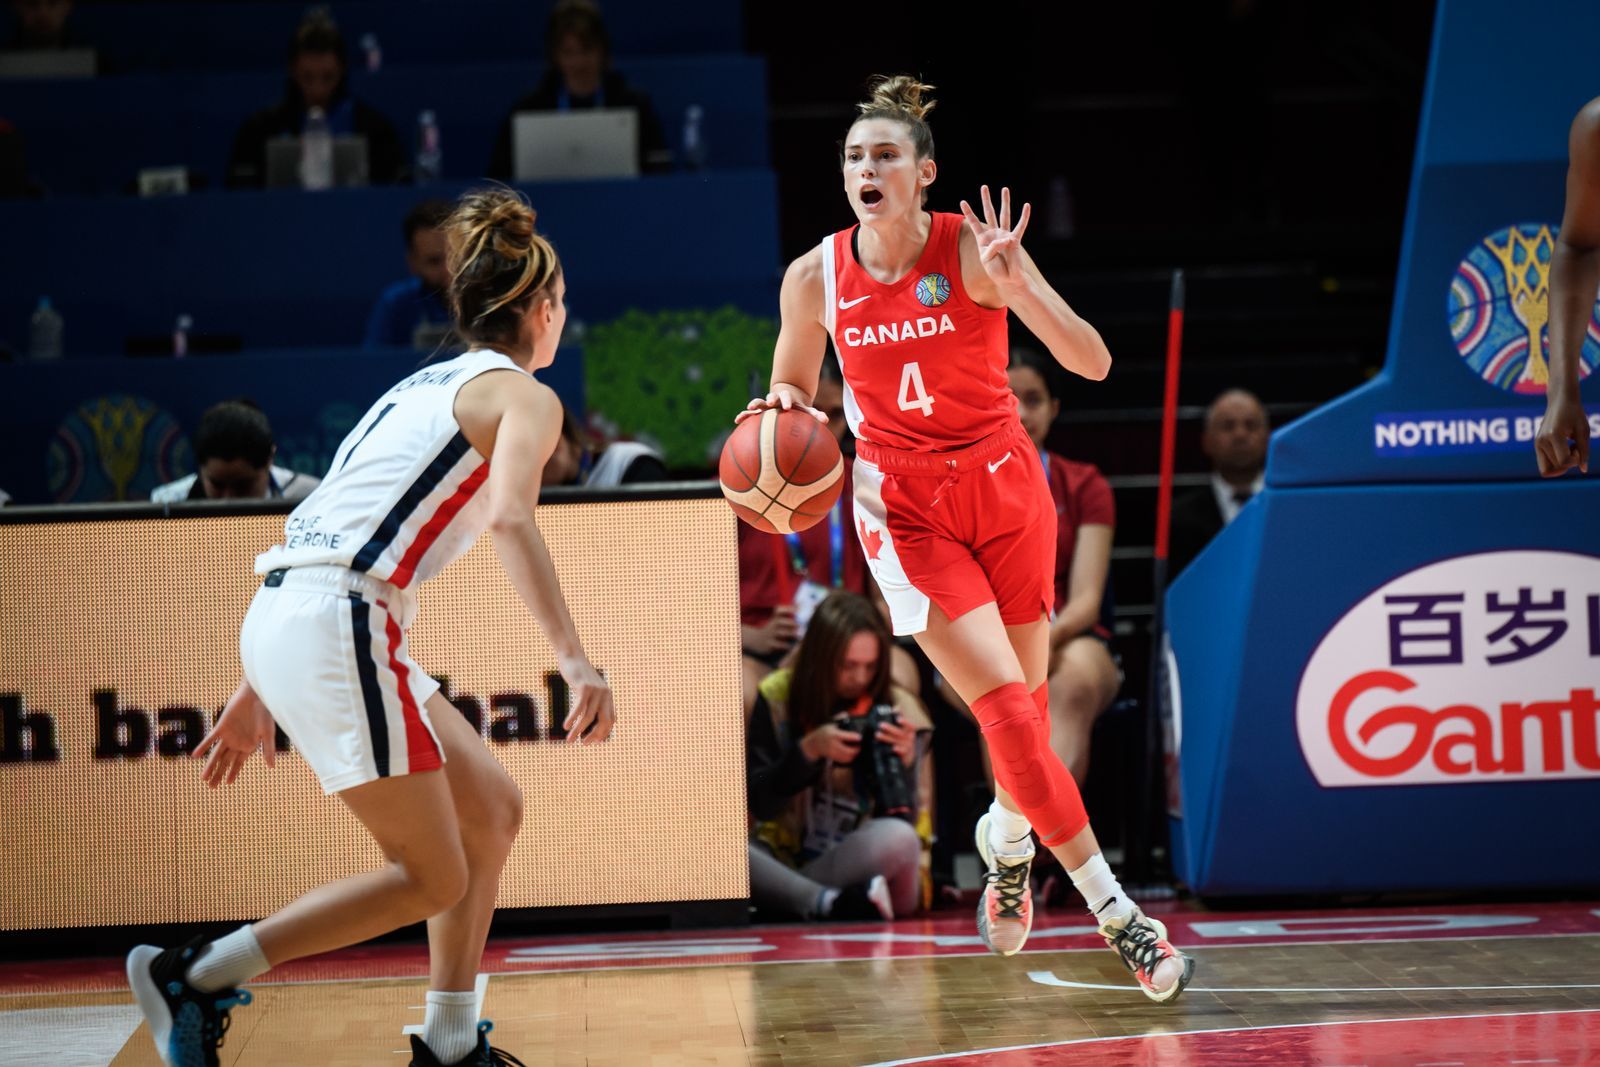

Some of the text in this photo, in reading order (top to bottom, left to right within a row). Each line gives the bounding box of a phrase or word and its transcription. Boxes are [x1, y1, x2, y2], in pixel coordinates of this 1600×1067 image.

[843, 313, 956, 347] CANADA
[897, 361, 935, 418] 4
[339, 402, 397, 473] 1
[1375, 417, 1510, 448] NOTHING
[1384, 587, 1600, 666] 百岁
